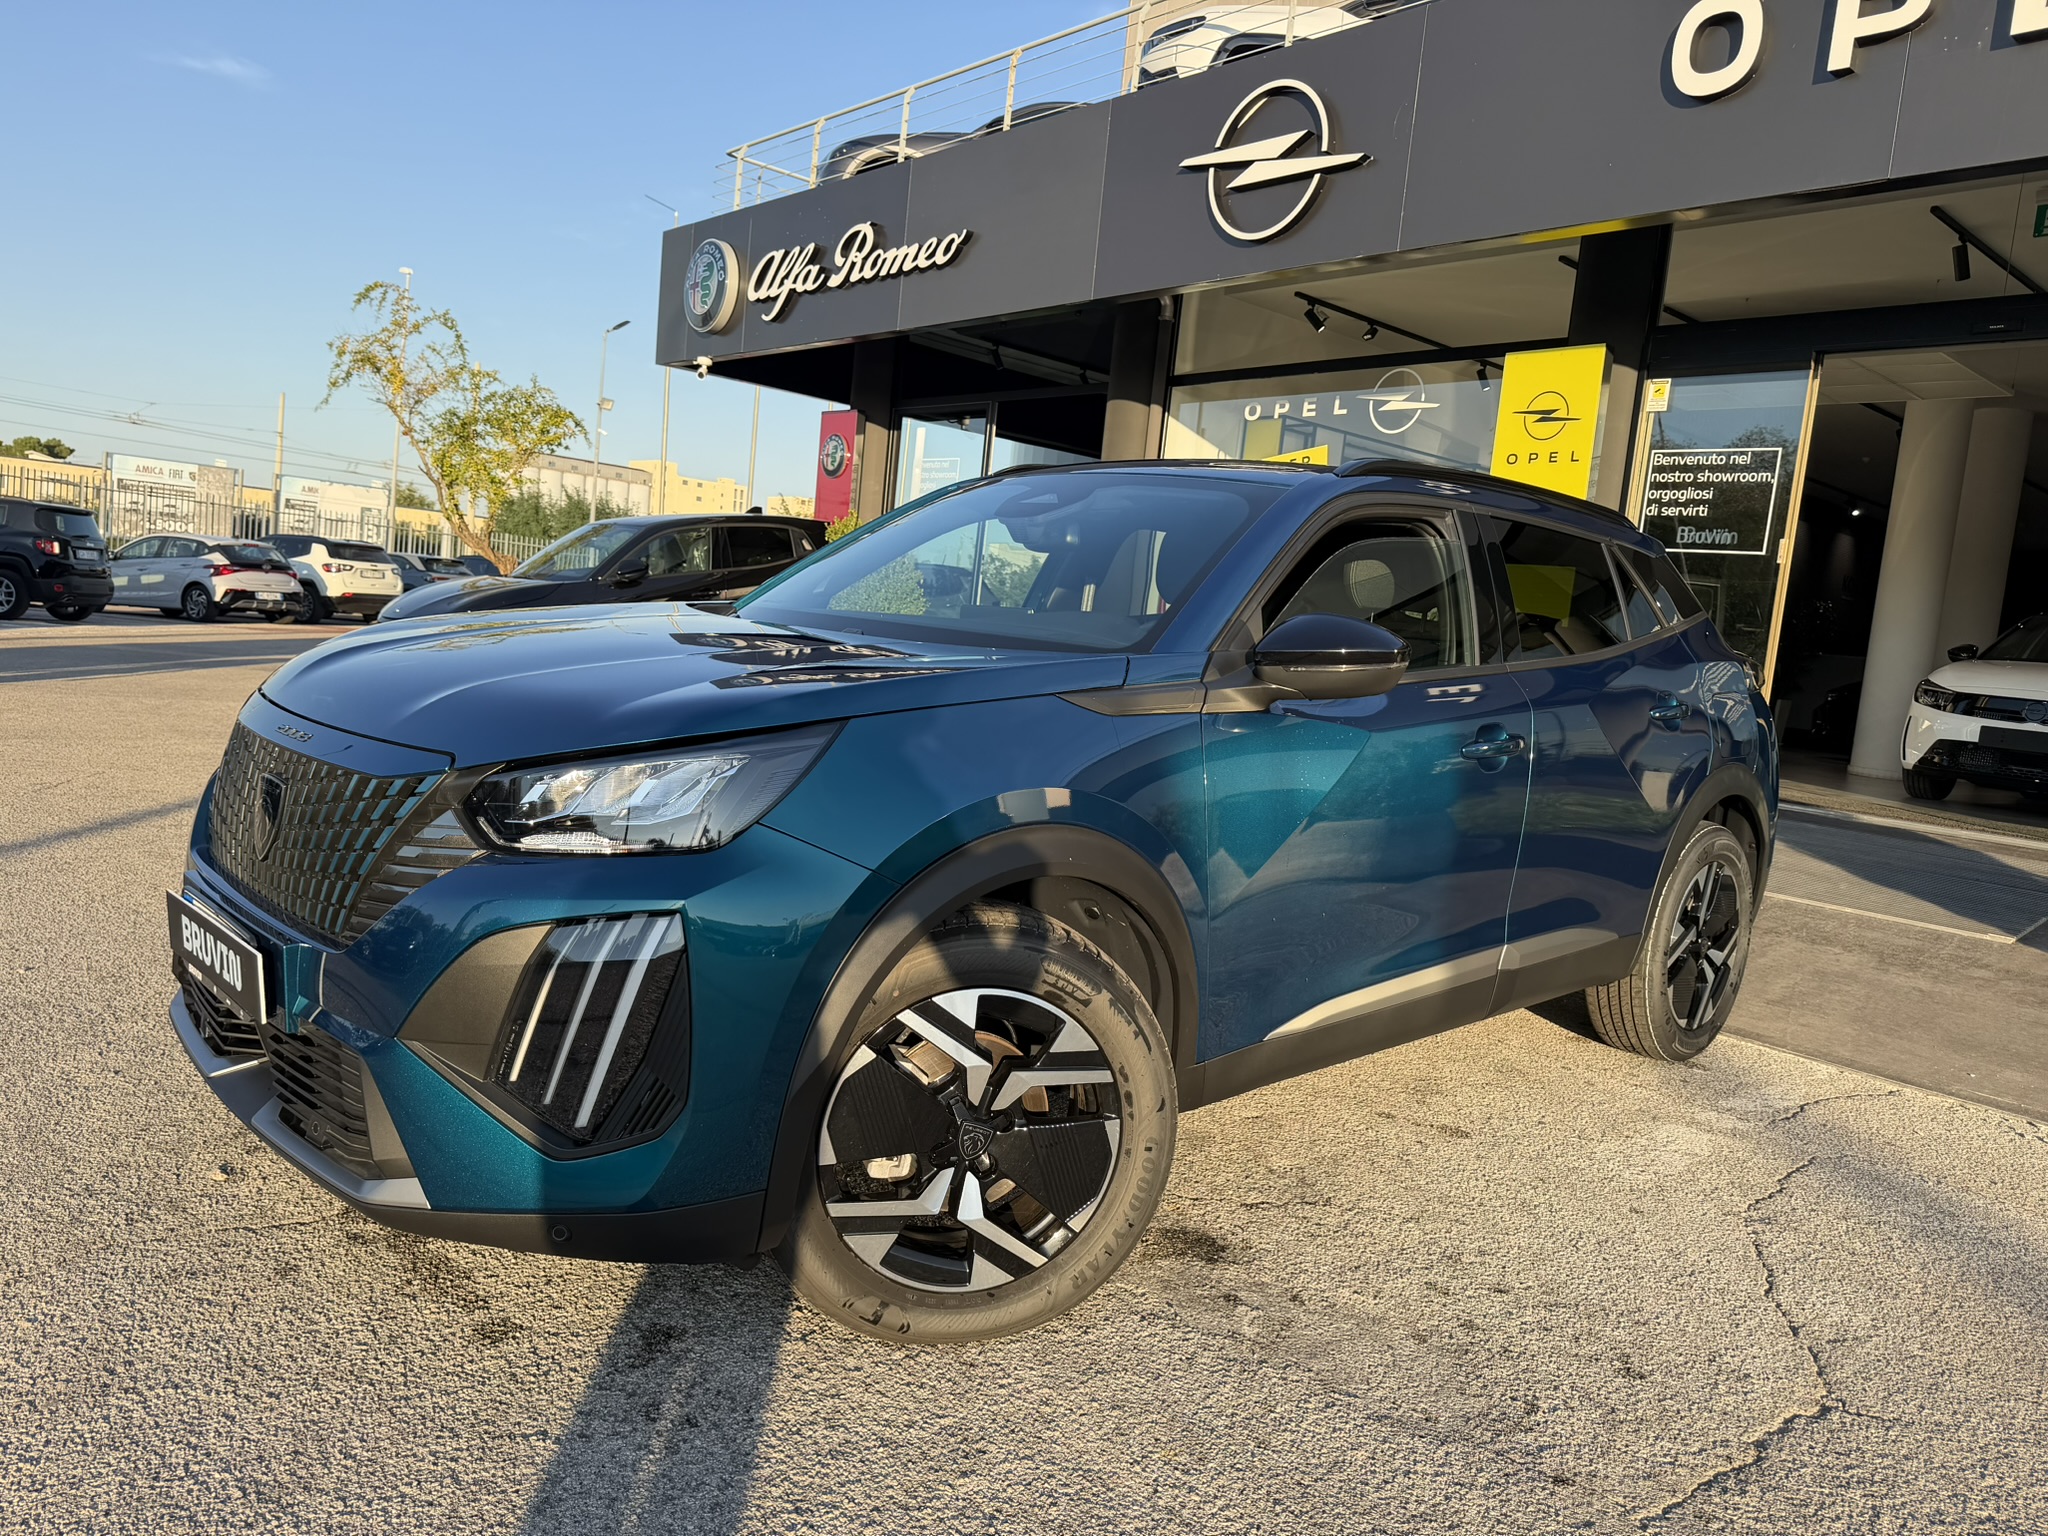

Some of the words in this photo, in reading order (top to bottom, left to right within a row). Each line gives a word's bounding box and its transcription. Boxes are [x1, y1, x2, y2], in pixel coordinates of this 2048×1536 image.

[1672, 0, 2048, 97] OP
[703, 244, 726, 282] ROMEO
[747, 242, 825, 321] Alfa
[826, 221, 968, 288] Romeo
[1244, 395, 1348, 421] OPEL
[1506, 450, 1580, 465] OPEL
[1653, 453, 1726, 465] Benvenuto
[1729, 451, 1751, 465] nel
[135, 464, 164, 476] AMICA
[168, 468, 184, 480] FIAT
[1651, 470, 1694, 482] nostro
[1696, 469, 1775, 484] showroom,
[1648, 487, 1714, 502] orgogliosi
[1646, 503, 1659, 516] di
[1661, 504, 1708, 516] servirti
[181, 913, 242, 991] BRUVIN
[964, 1126, 991, 1136] PEUGEOT
